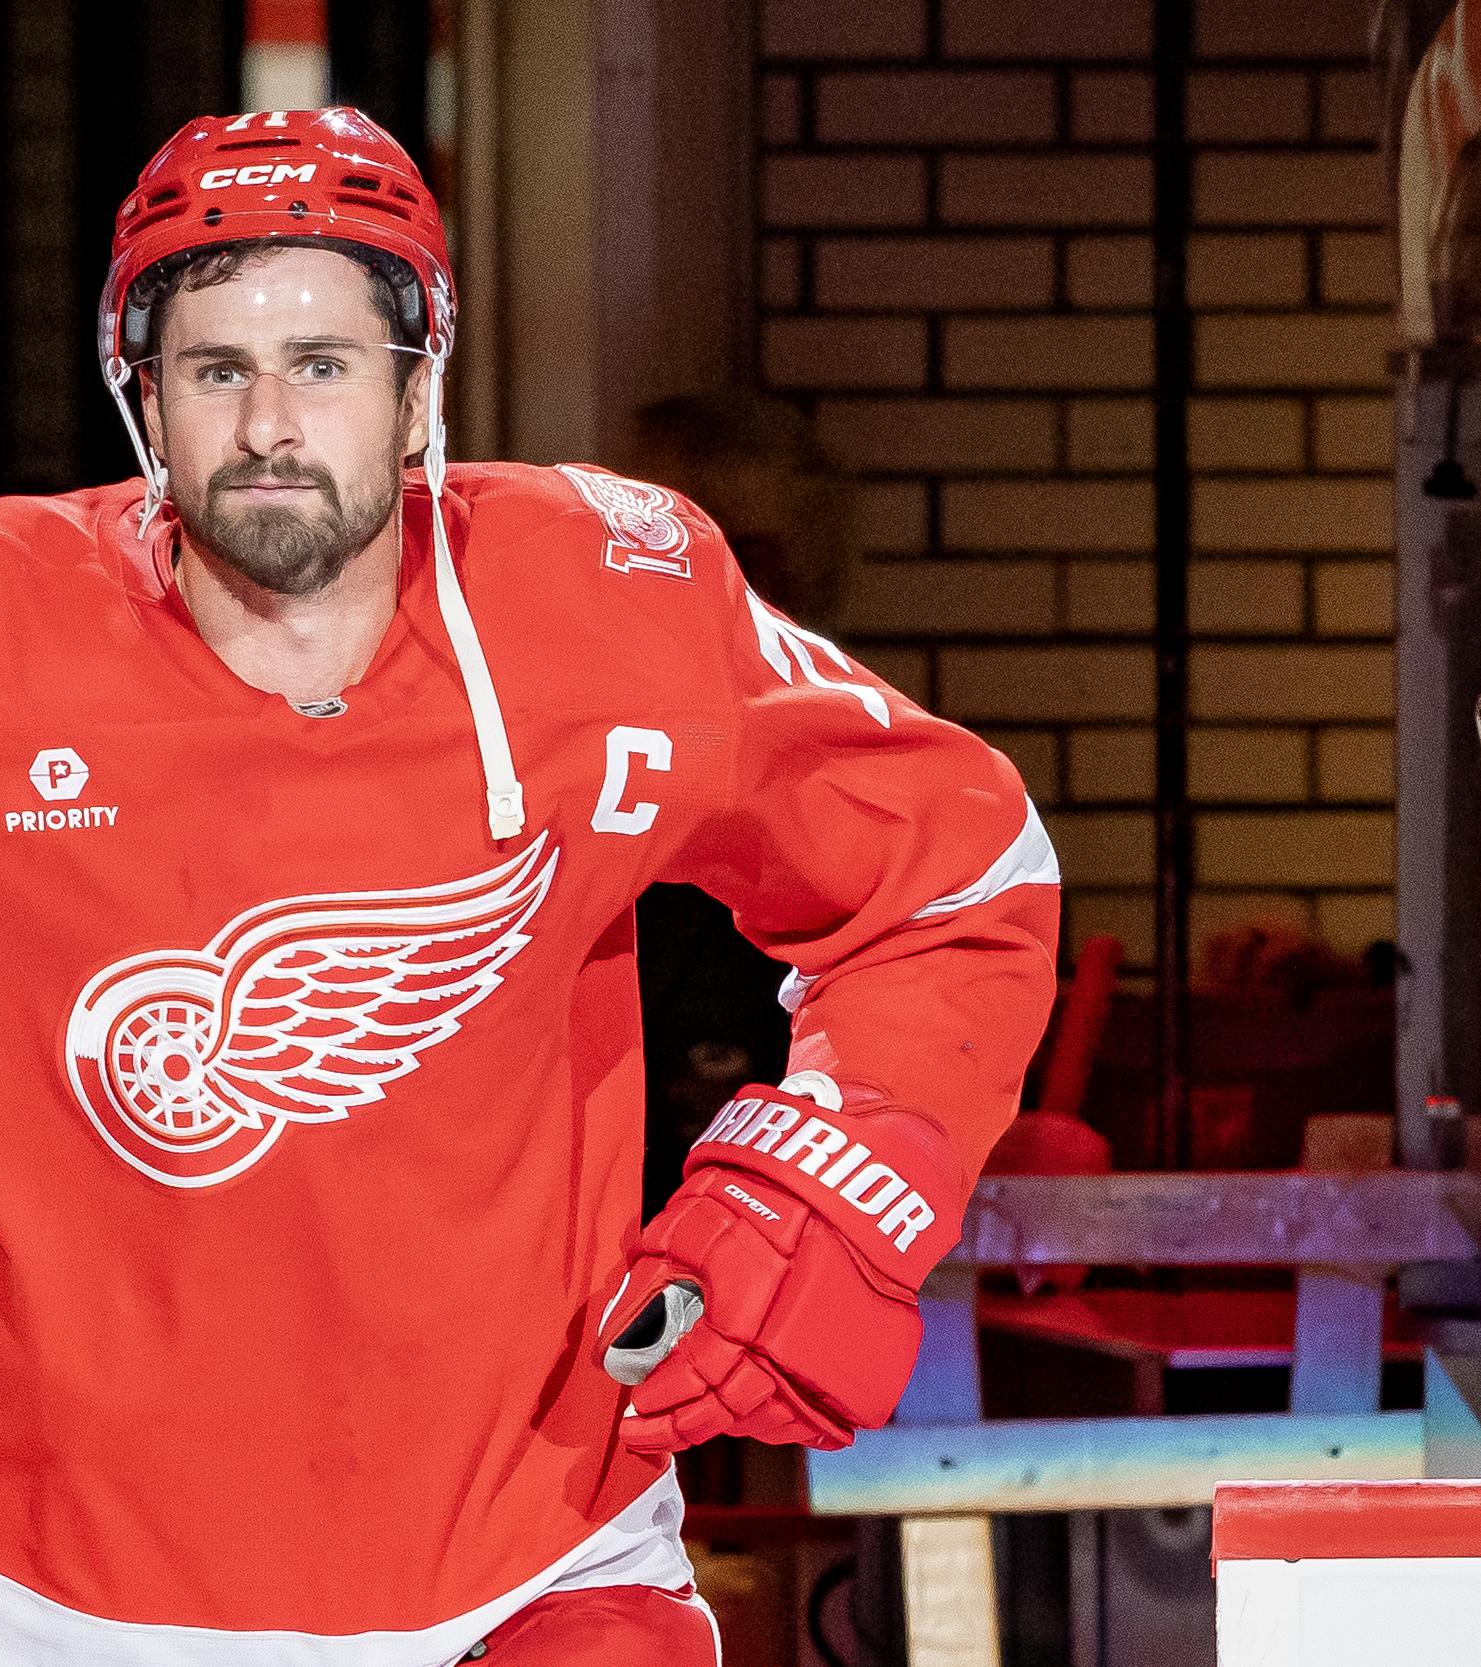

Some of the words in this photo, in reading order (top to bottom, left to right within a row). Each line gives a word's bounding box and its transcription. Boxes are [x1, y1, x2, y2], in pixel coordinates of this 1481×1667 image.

[199, 163, 317, 190] CCM
[590, 725, 673, 836] C
[5, 806, 119, 832] PRIORITY
[724, 1184, 782, 1222] COVERT
